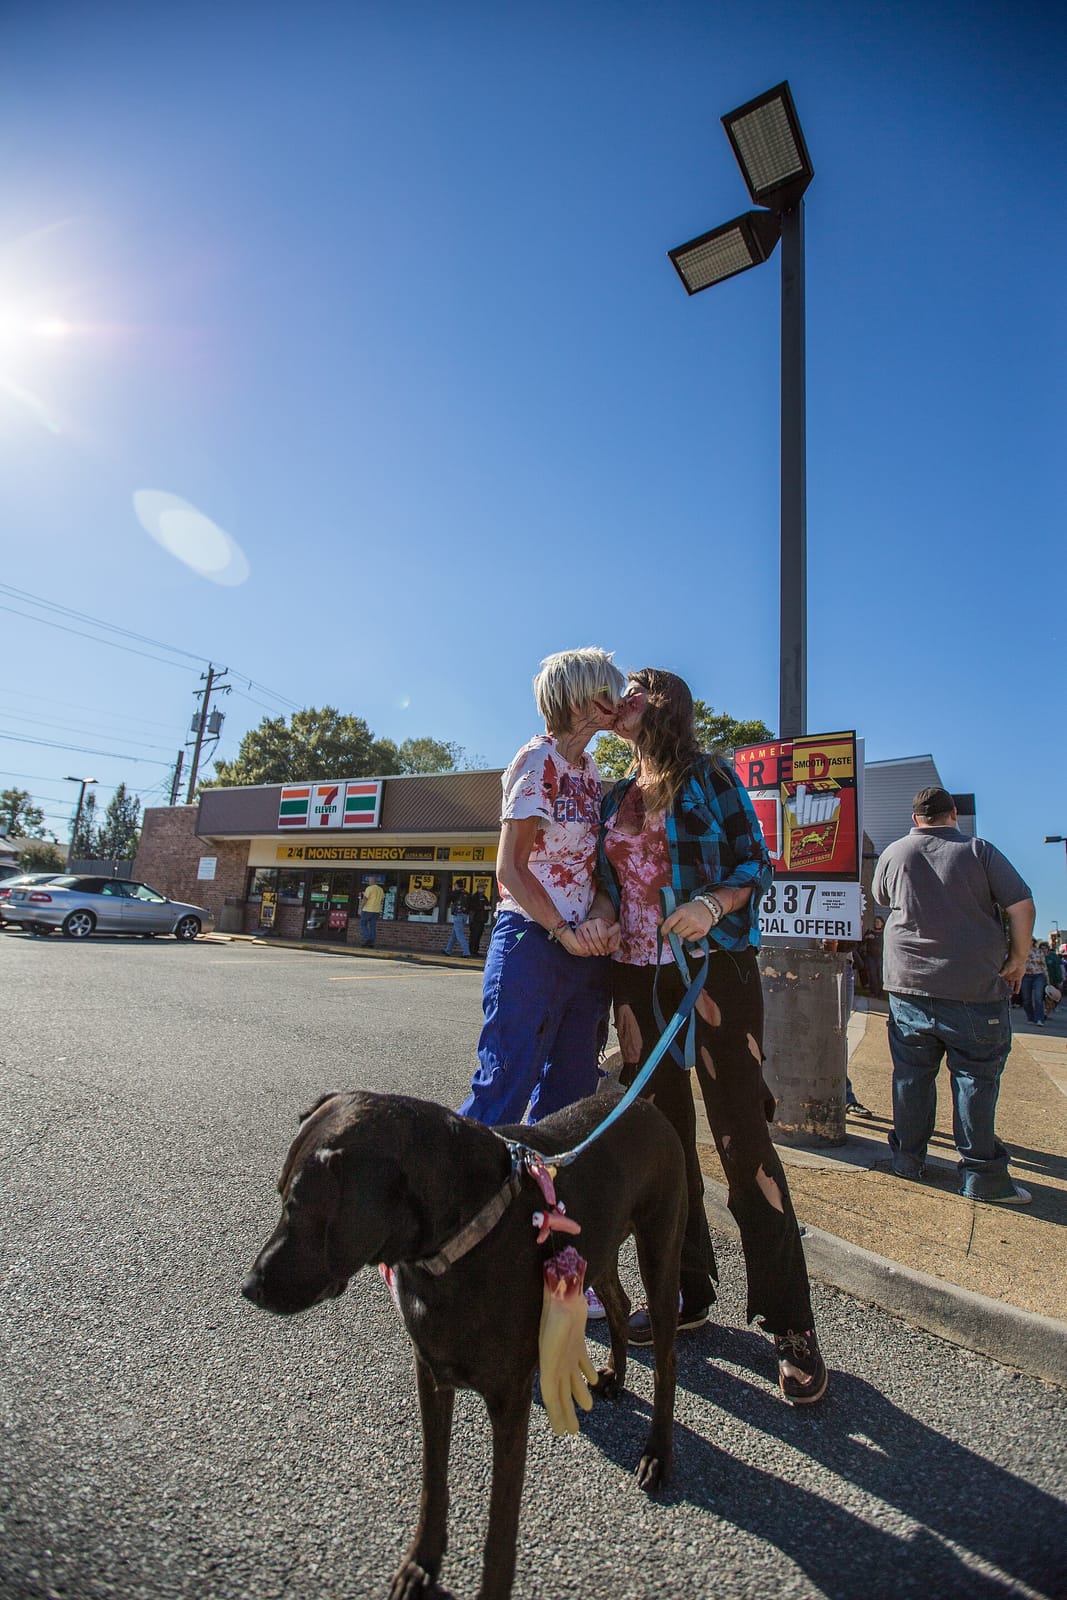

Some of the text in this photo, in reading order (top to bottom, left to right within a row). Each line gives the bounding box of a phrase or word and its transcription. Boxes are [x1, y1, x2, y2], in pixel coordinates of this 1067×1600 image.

[741, 747, 785, 762] KAMEL
[794, 756, 852, 769] SMOOTH TASTE
[748, 752, 830, 788] RED
[317, 785, 338, 826] 7
[308, 848, 358, 859] MONSTER
[360, 848, 407, 860] ENERGY
[794, 919, 852, 937] OFFER!
